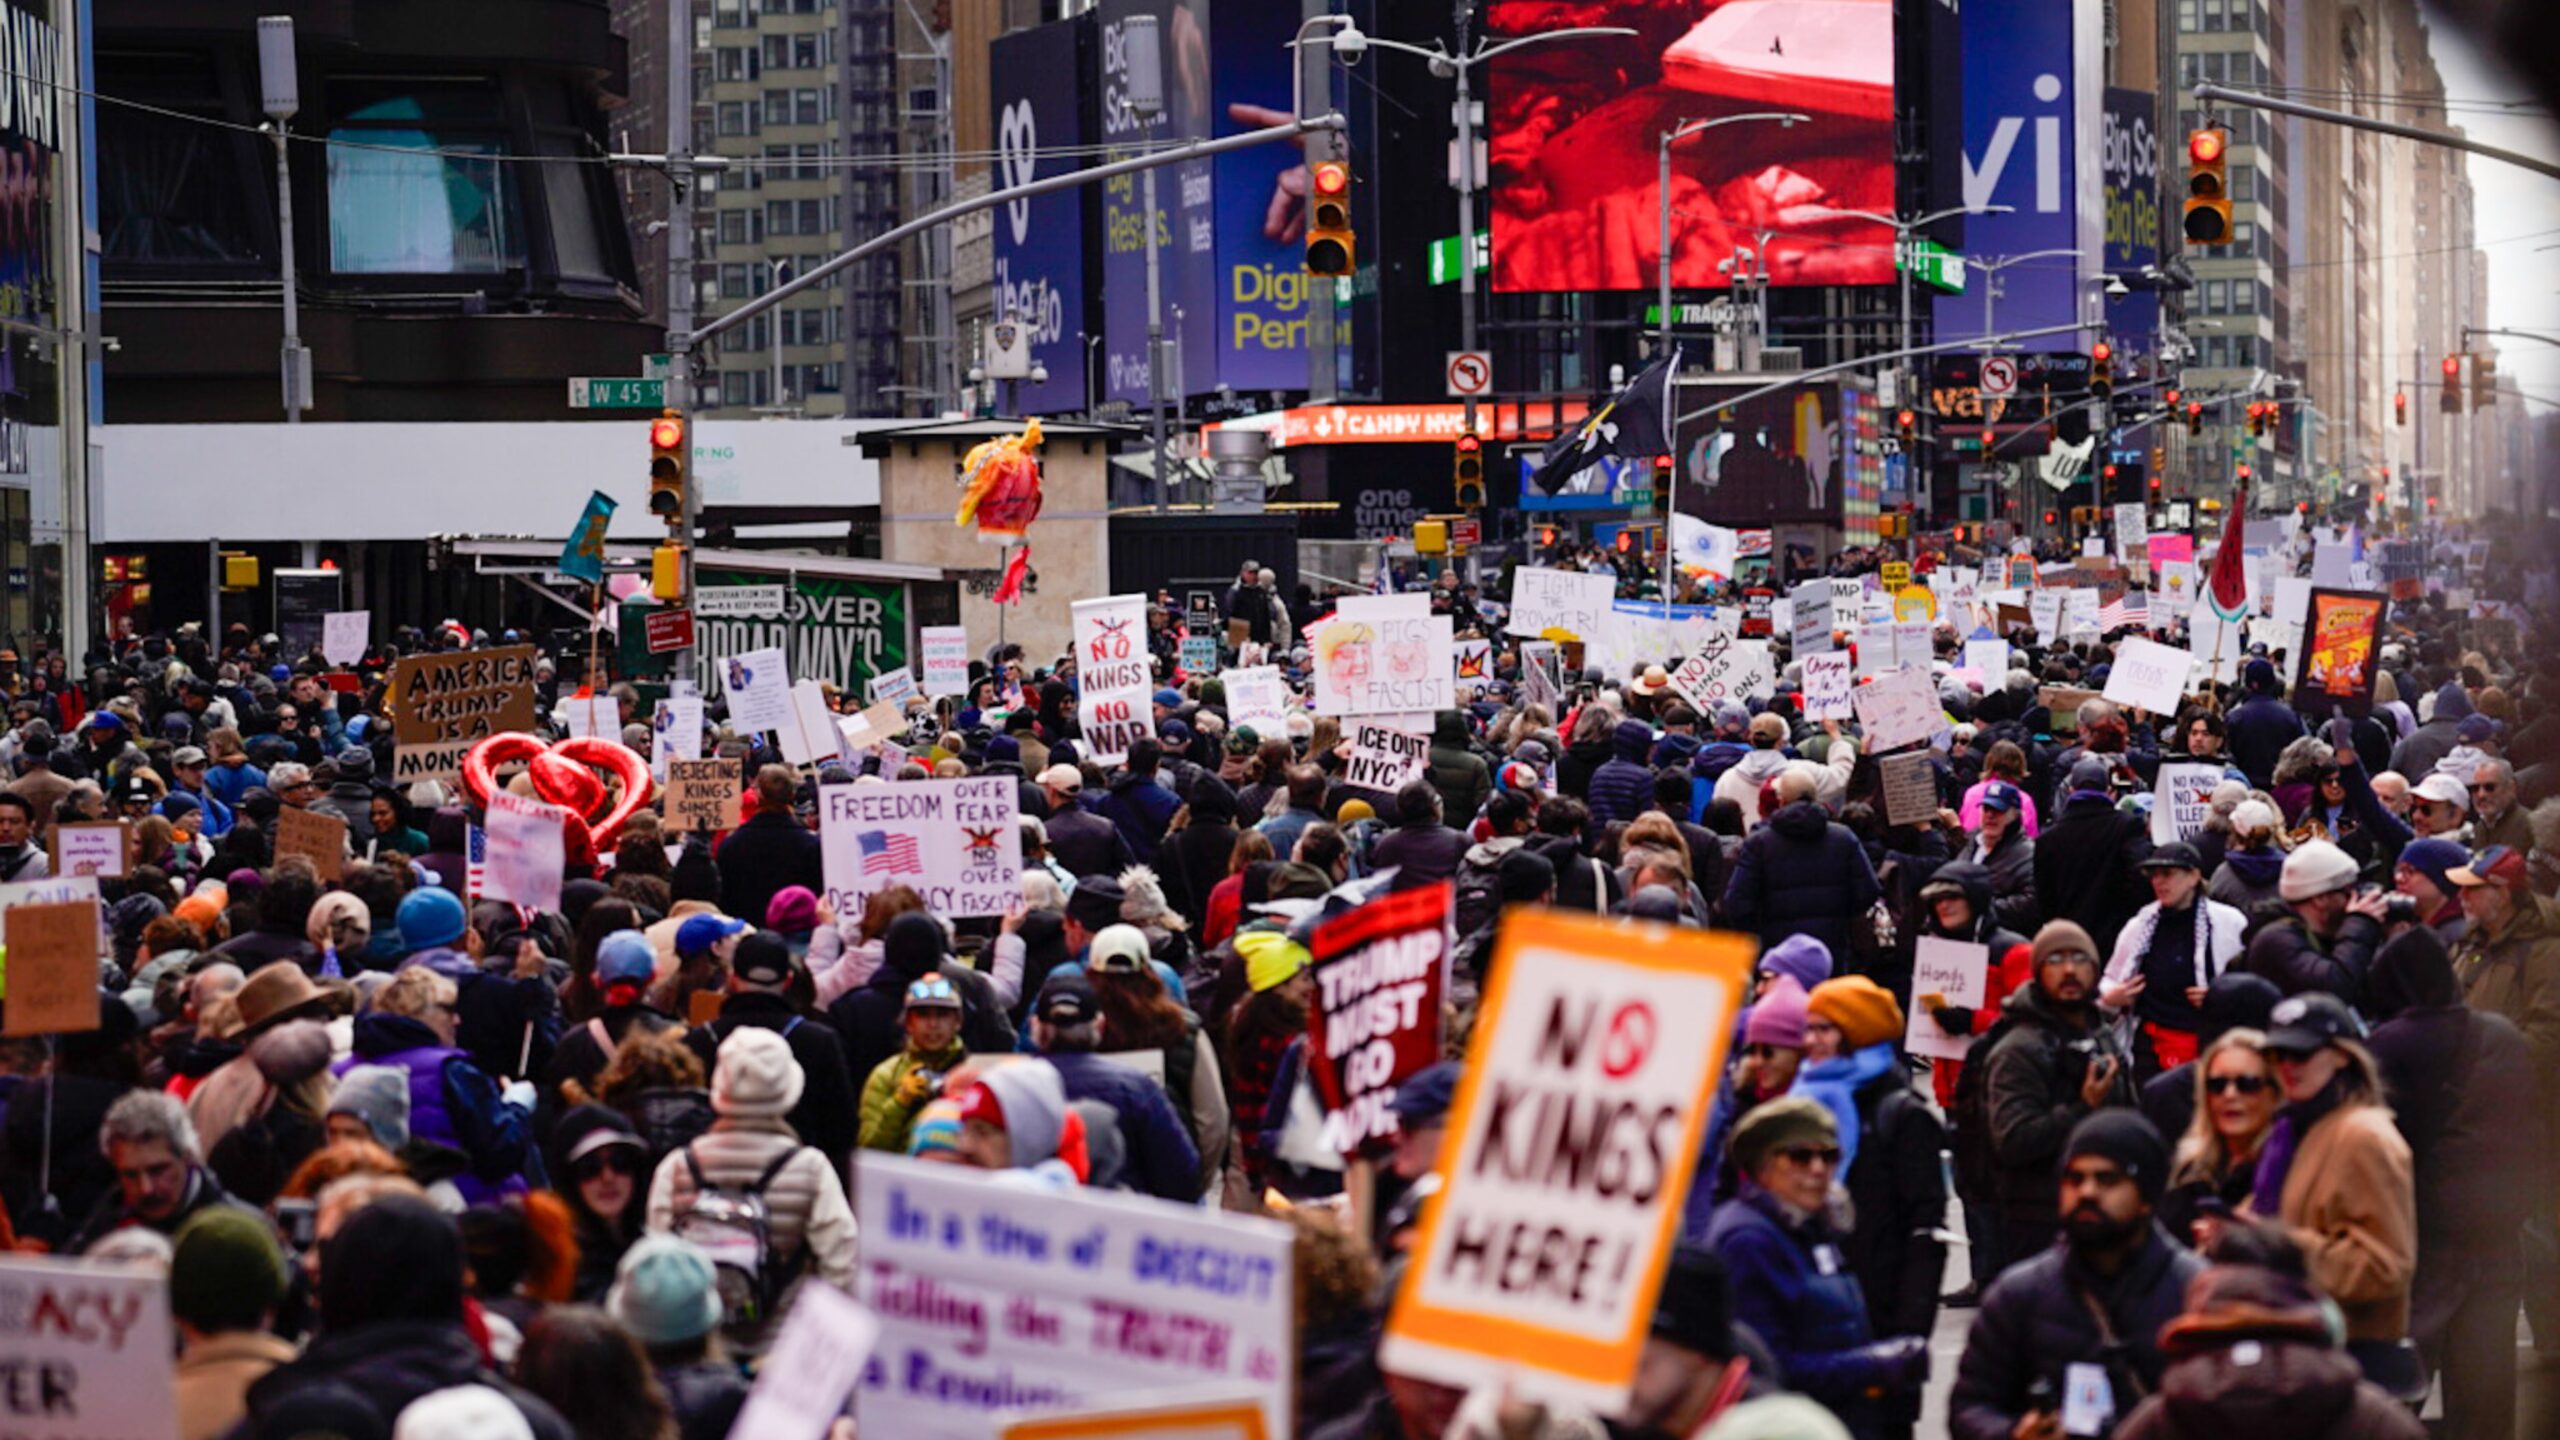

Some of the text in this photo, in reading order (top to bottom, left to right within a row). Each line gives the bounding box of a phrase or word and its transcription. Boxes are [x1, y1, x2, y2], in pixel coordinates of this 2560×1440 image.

[2103, 112, 2131, 189] Big
[2104, 185, 2131, 261] Big
[593, 383, 610, 403] W
[620, 383, 641, 404] 45
[1348, 413, 1466, 435] CANDY NYC
[1359, 489, 1412, 508] one
[1354, 506, 1430, 527] times
[761, 587, 777, 597] ZONE
[1524, 573, 1595, 598] FIGHT
[754, 601, 779, 610] MOVING
[1382, 619, 1433, 643] PIGS
[1090, 635, 1131, 662] NO
[693, 620, 881, 707] BRWAY'S
[1083, 662, 1142, 692] KINGS
[1676, 658, 1706, 691] NO
[408, 655, 536, 702] AMERICA
[1691, 659, 1731, 699] KINGS
[414, 690, 513, 723] TRUMP
[1368, 678, 1444, 708] FASCIST
[1699, 682, 1726, 711] NO
[1094, 700, 1131, 722] NO
[437, 716, 492, 741] IS A
[1357, 725, 1425, 760] ICE OUT
[670, 761, 740, 781] REJECTING
[1350, 757, 1398, 788] NYC
[2172, 776, 2219, 787] NO KINGS
[684, 783, 732, 799] KINGS
[954, 781, 1008, 800] OVER
[2174, 790, 2191, 805] NO
[677, 801, 722, 814] SINCE
[686, 812, 724, 827] 176
[830, 792, 943, 822] FREEDOM
[955, 803, 1010, 822] FEAR
[972, 848, 997, 861] NO
[961, 867, 1014, 884] OVER
[828, 888, 955, 916] DEMACY
[1316, 928, 1443, 1012] TRUMP
[1920, 962, 1966, 983] Hands
[1325, 980, 1428, 1060] MUST
[1532, 995, 1658, 1080] NO
[1344, 1038, 1396, 1097] GO
[1472, 1080, 1682, 1207] KINGS
[942, 1213, 963, 1250] a
[1443, 1210, 1634, 1312] HERE!
[868, 1258, 988, 1358] Telling
[1090, 1297, 1232, 1375] TRUTH
